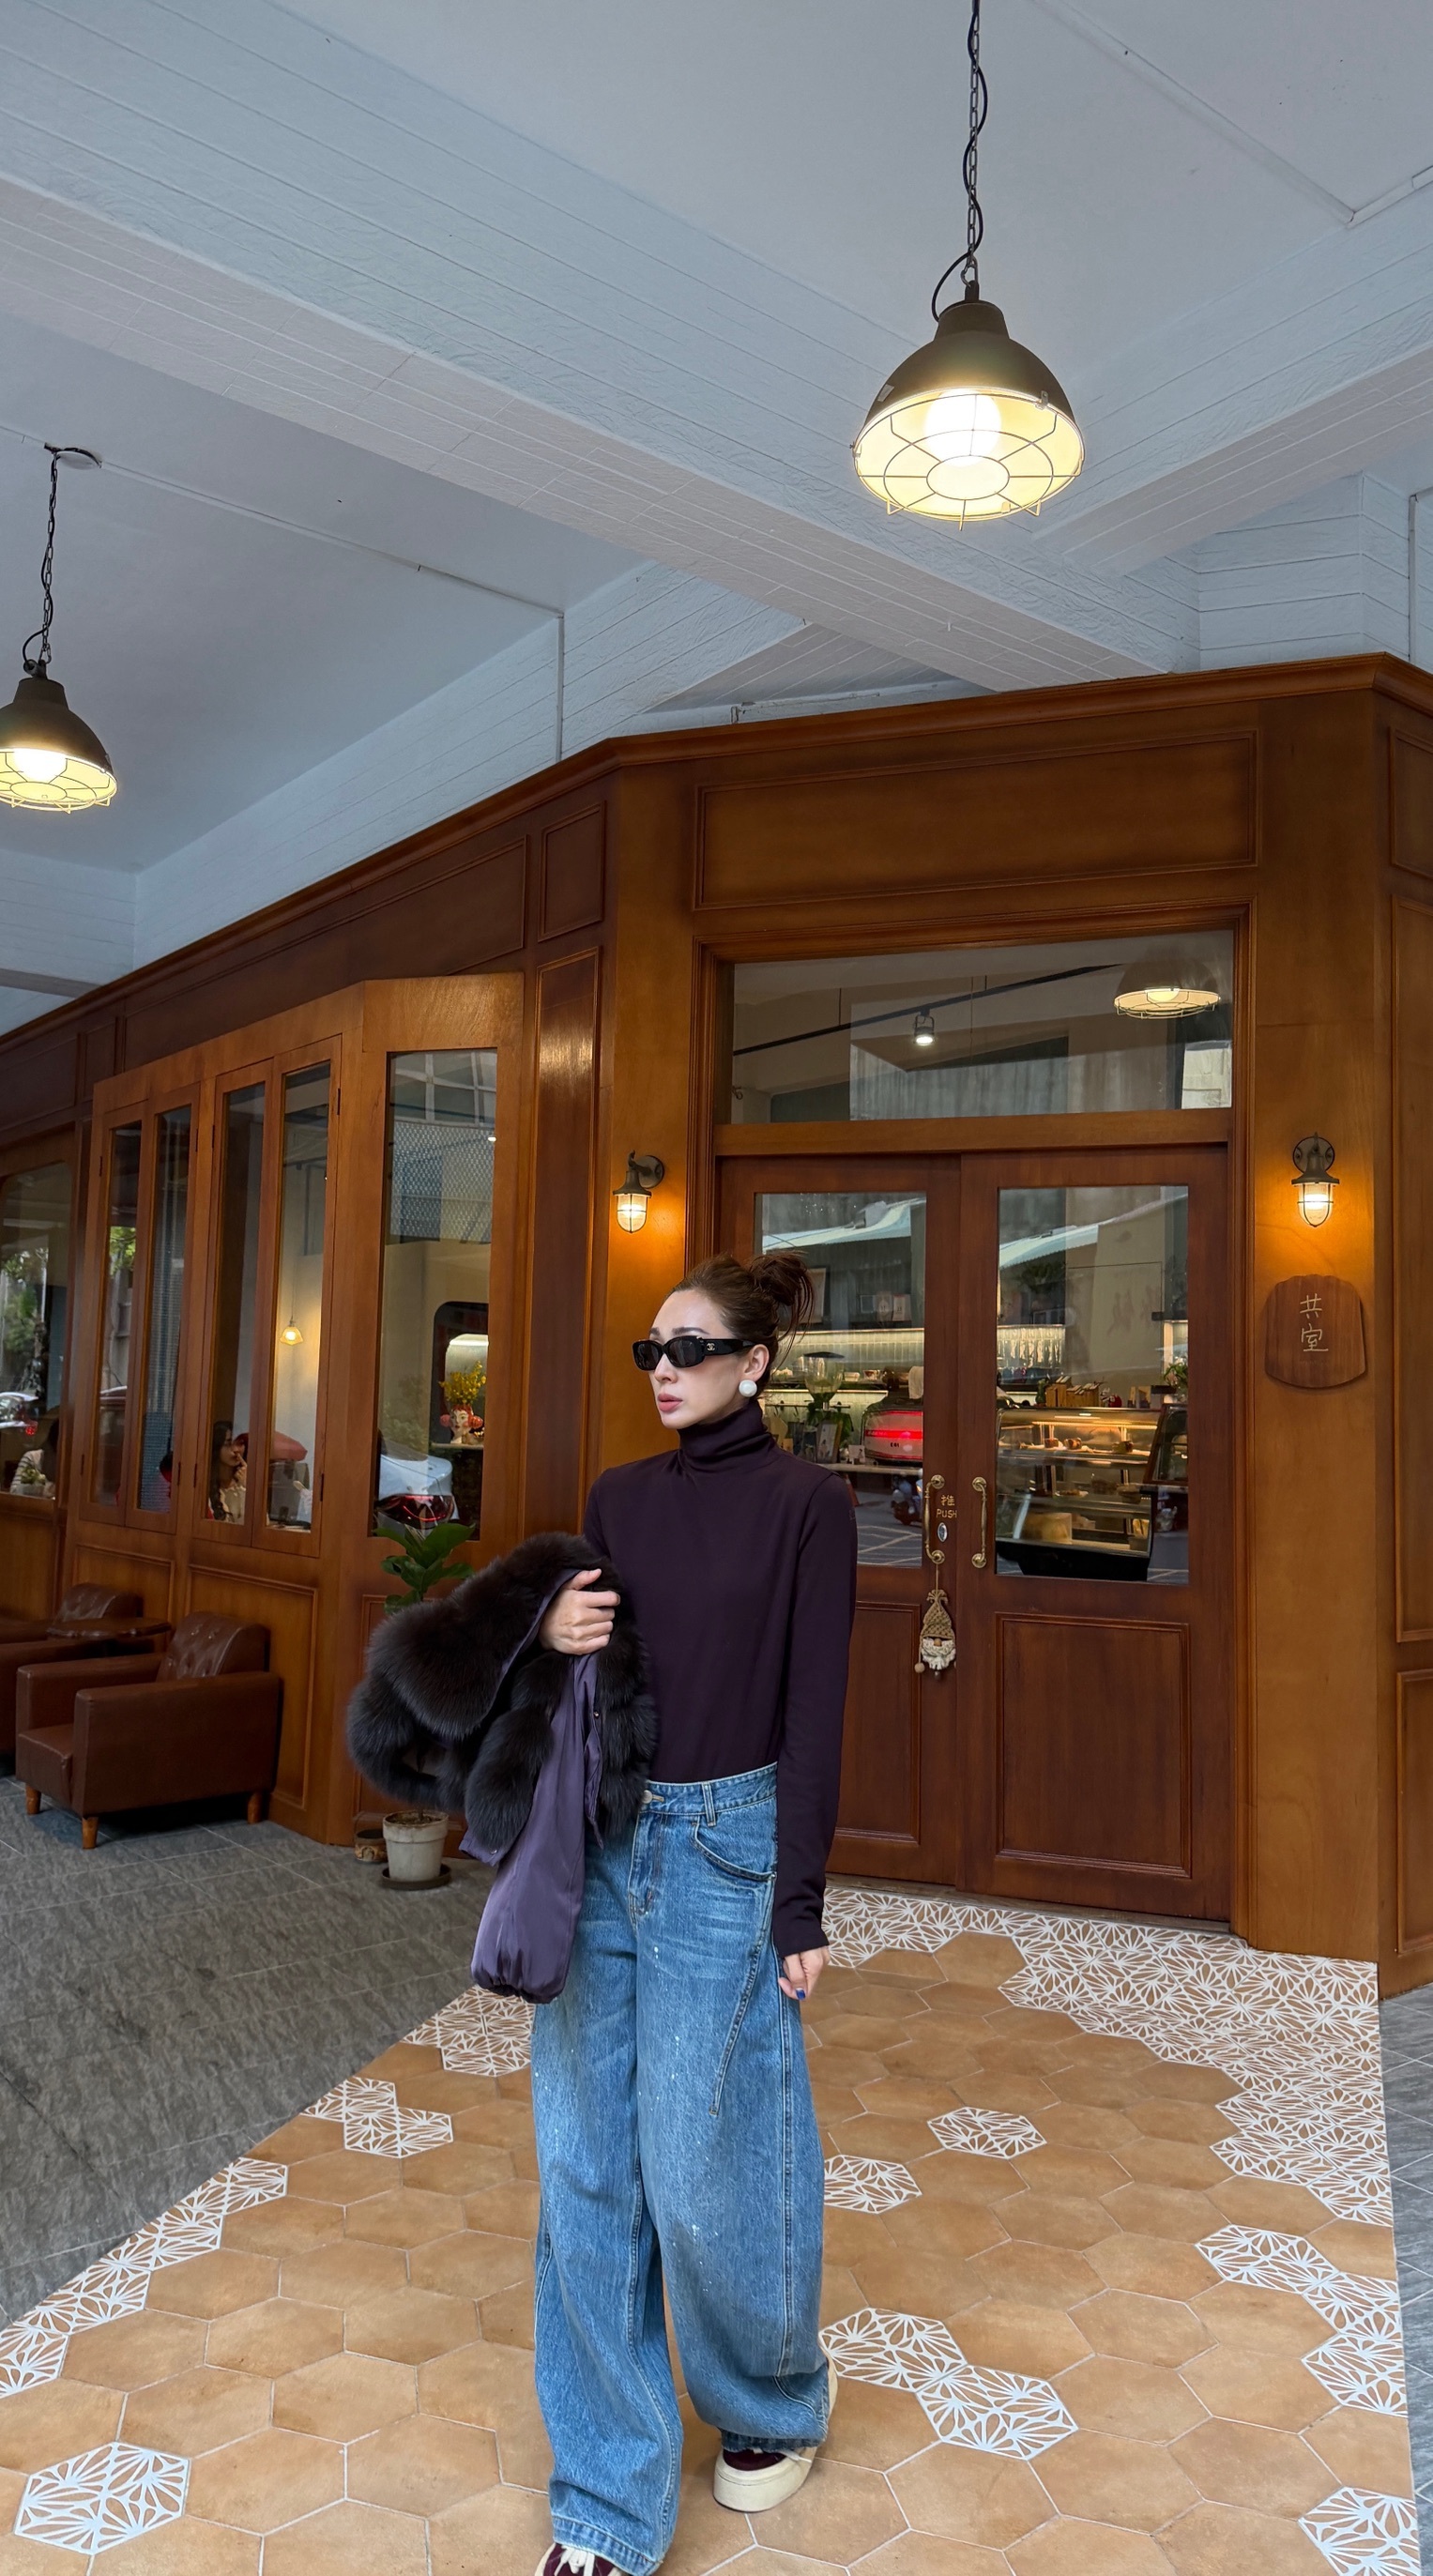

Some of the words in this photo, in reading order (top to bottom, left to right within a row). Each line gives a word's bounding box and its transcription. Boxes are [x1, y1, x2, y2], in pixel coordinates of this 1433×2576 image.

[1300, 1293, 1329, 1352] 共室
[941, 1495, 954, 1505] 推
[936, 1508, 957, 1518] PUSH
